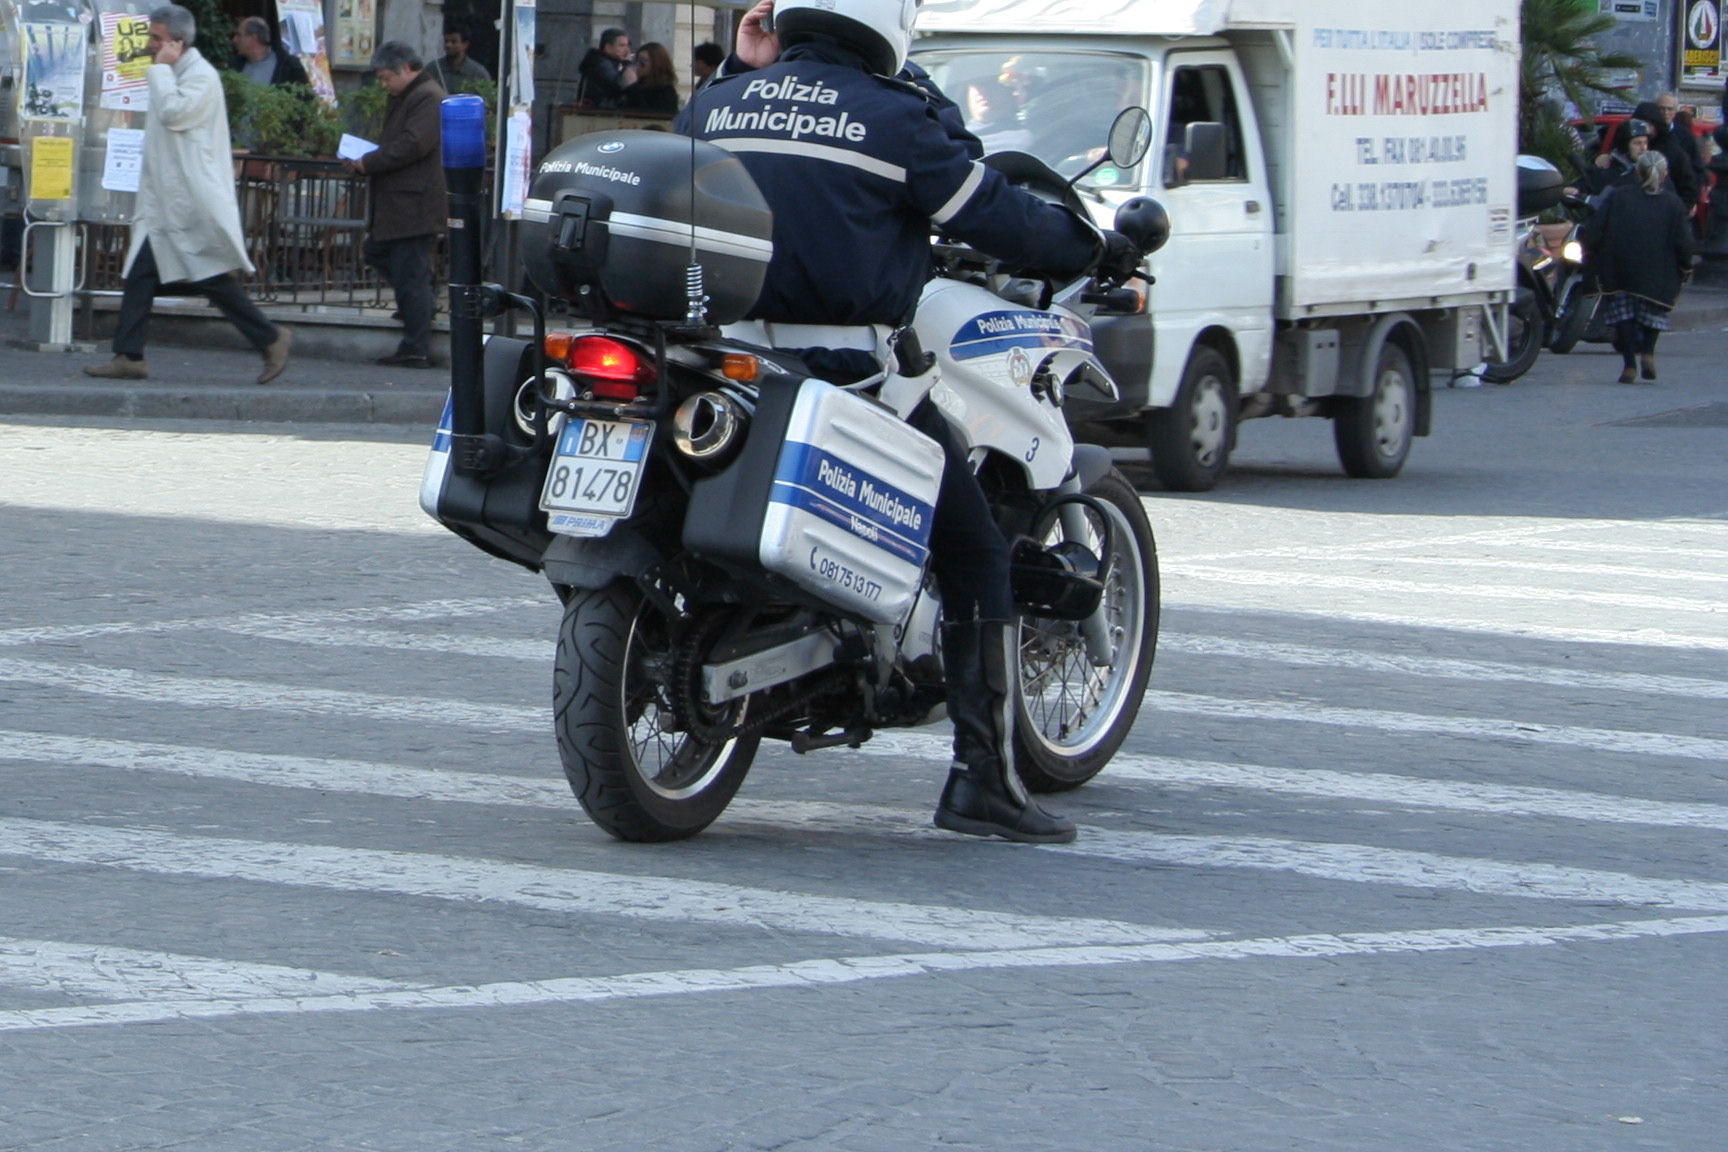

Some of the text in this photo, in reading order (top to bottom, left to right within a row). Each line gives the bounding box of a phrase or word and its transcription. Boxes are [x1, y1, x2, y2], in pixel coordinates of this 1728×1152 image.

[118, 21, 149, 36] U2
[741, 75, 839, 105] Polizia
[1326, 73, 1488, 115] F.LLI MARUZZELLA
[704, 104, 867, 142] Municipale
[539, 160, 642, 186] Polizia Municipale
[976, 315, 1016, 334] Polizia
[578, 421, 617, 457] BX
[1025, 437, 1040, 463] 3
[552, 465, 633, 503] 81478
[817, 459, 922, 531] Polizia Municipale
[565, 516, 606, 530] PRIMA
[850, 515, 879, 541] Napoli
